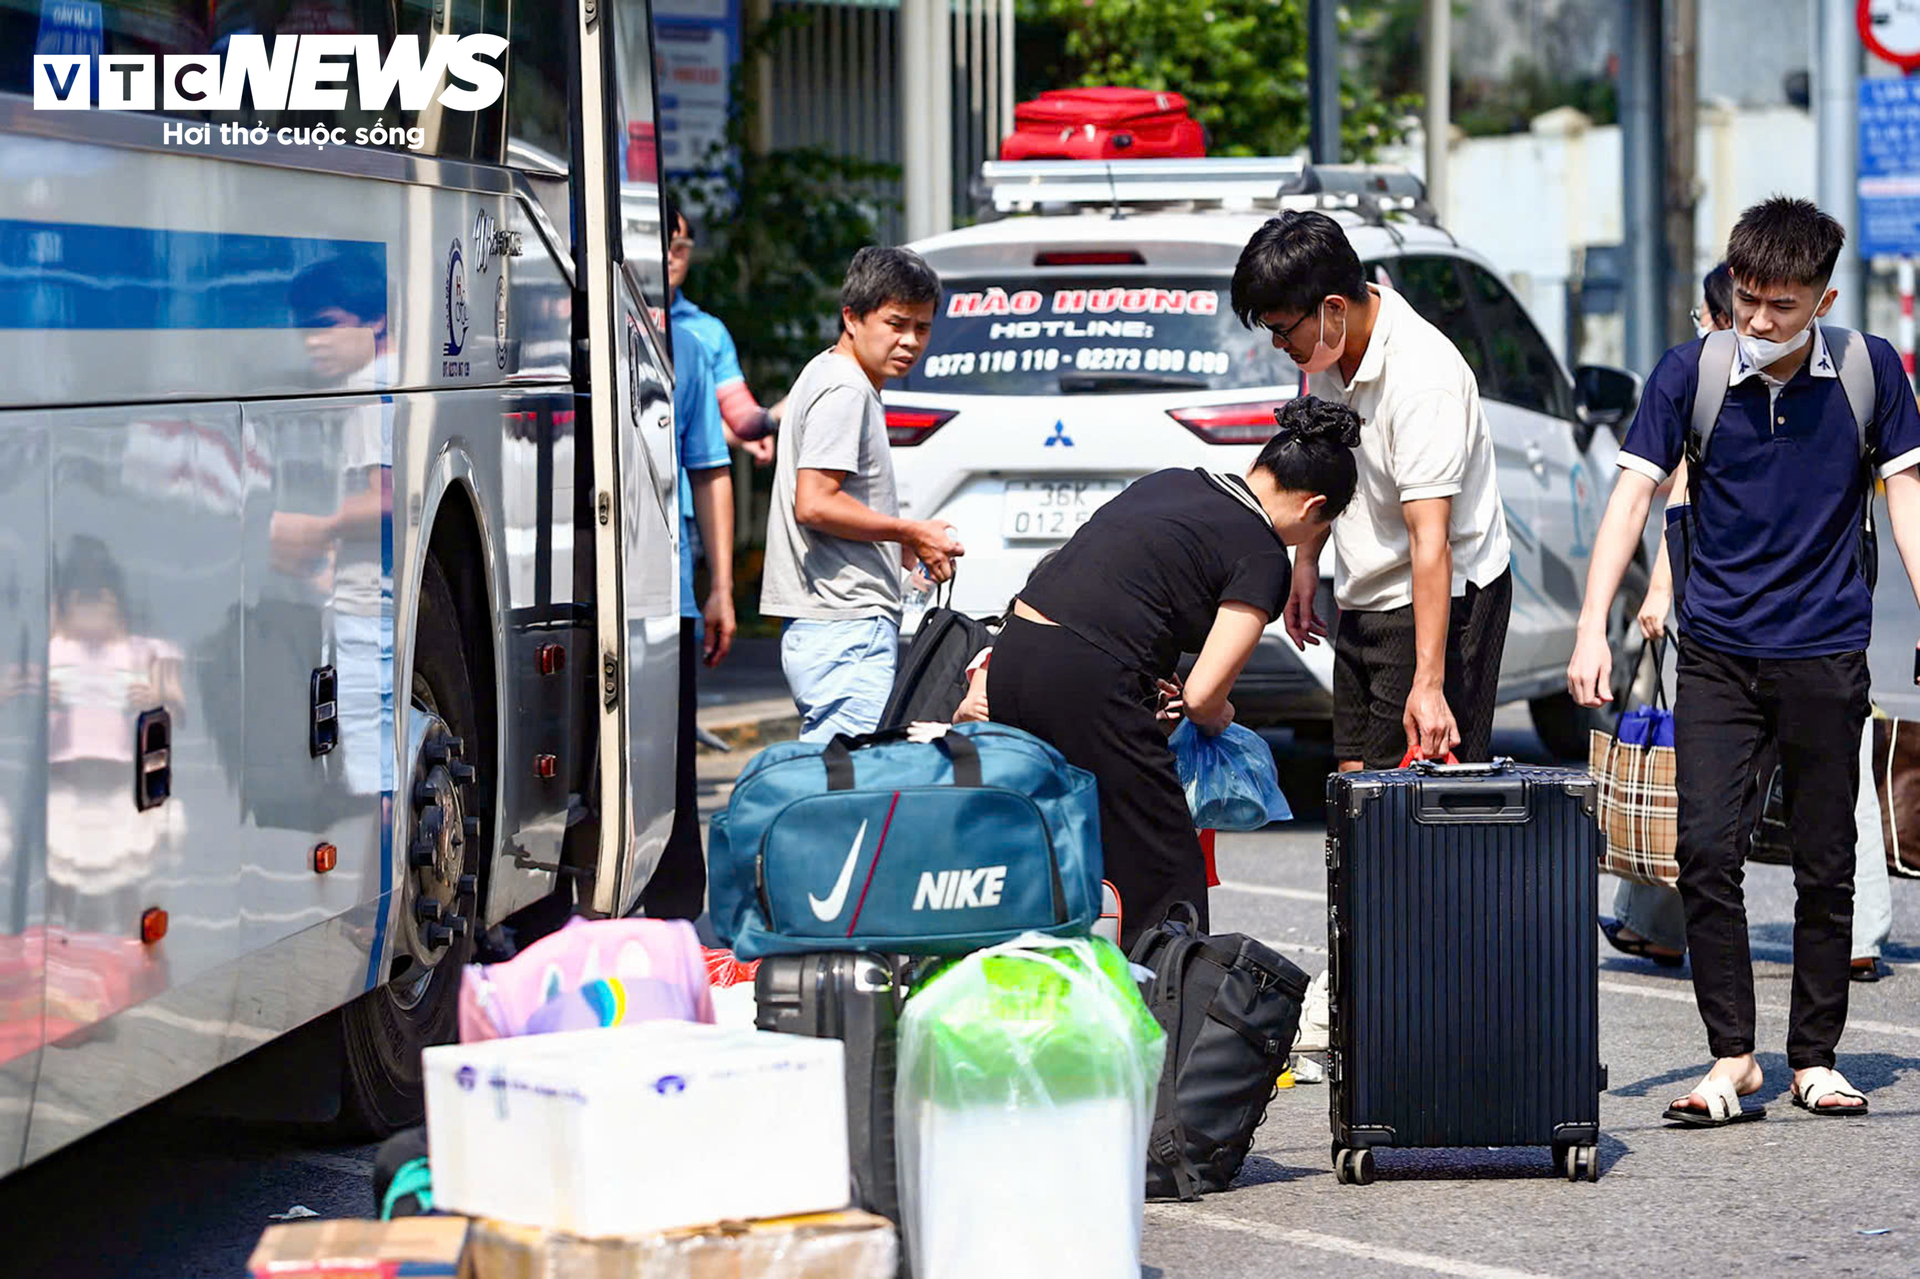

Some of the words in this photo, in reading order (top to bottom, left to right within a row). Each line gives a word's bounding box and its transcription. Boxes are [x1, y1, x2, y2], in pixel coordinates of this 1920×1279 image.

[946, 286, 1043, 318] HÀO
[1051, 287, 1219, 315] HƯƠNG
[989, 319, 1154, 339] HOTLINE:
[912, 865, 1008, 911] NIKE
